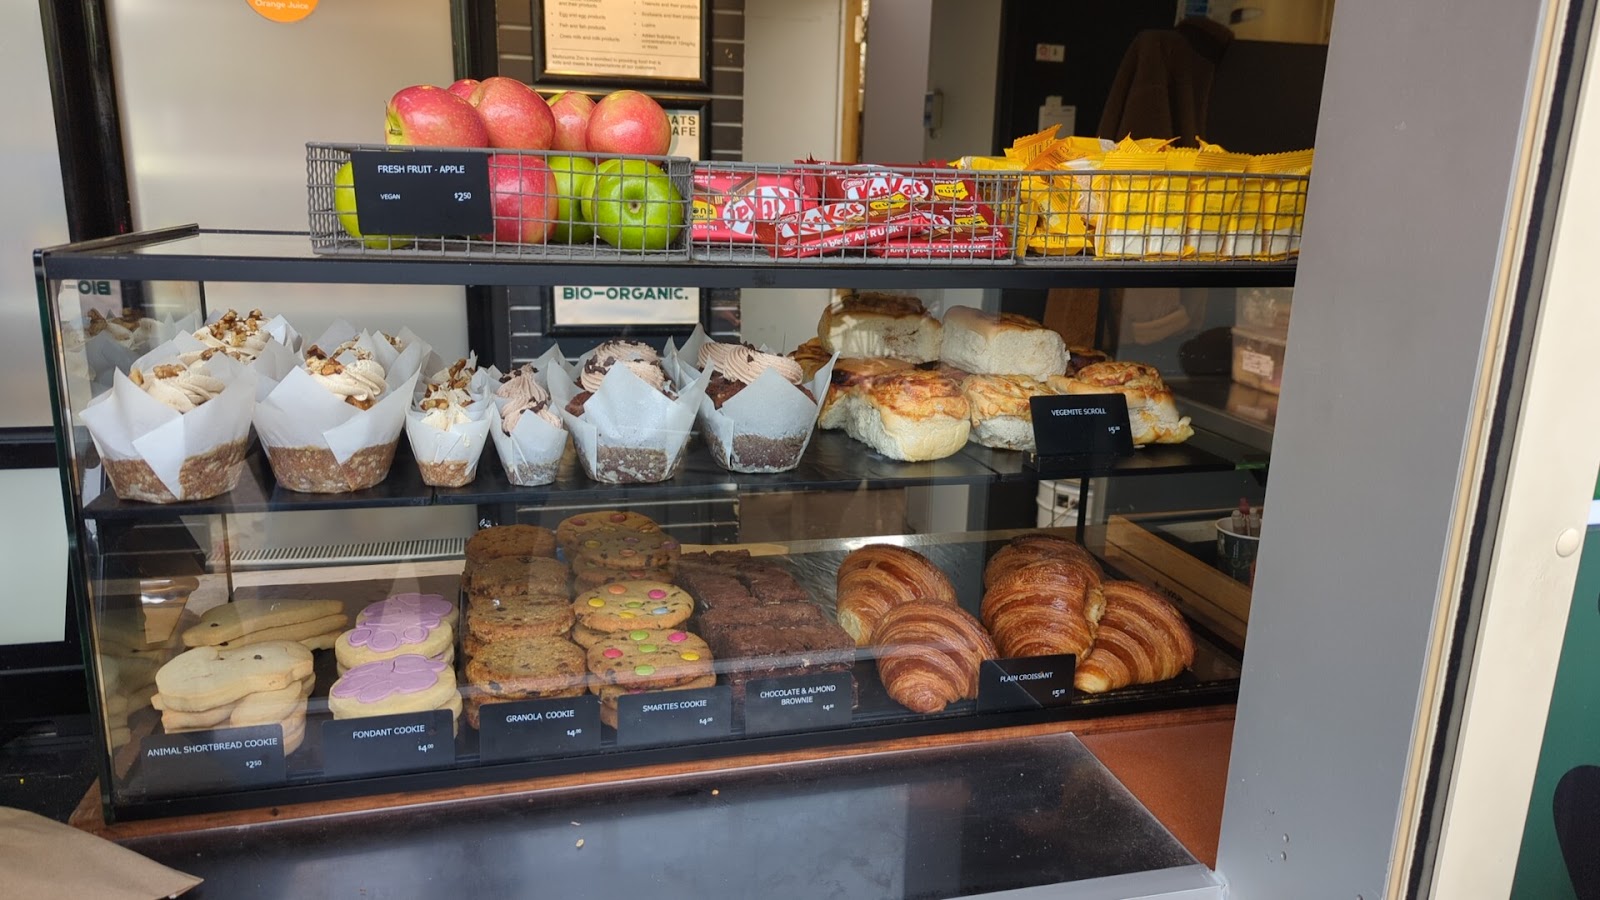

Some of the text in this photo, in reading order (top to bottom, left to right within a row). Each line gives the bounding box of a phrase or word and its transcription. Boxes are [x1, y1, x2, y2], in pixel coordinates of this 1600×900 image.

[255, 0, 285, 9] Orange
[670, 115, 696, 126] ATS
[672, 126, 696, 136] AFE
[377, 165, 405, 174] FRESH
[407, 165, 433, 174] FRUIT
[440, 165, 465, 174] APPLE
[1051, 408, 1083, 416] VEGEMITE
[1019, 672, 1053, 680] CROISSANT
[760, 688, 800, 698] CHOCOLATE
[808, 685, 836, 693] ALMOND
[781, 696, 813, 705] BROWNIE
[642, 700, 707, 712] SMARTIES COOKIE
[506, 710, 574, 723] GRANOLA COOKIE
[352, 724, 425, 739] FONDANT COOKIE
[147, 737, 278, 757] ANIMAL SHORTBREAD COOKIE
